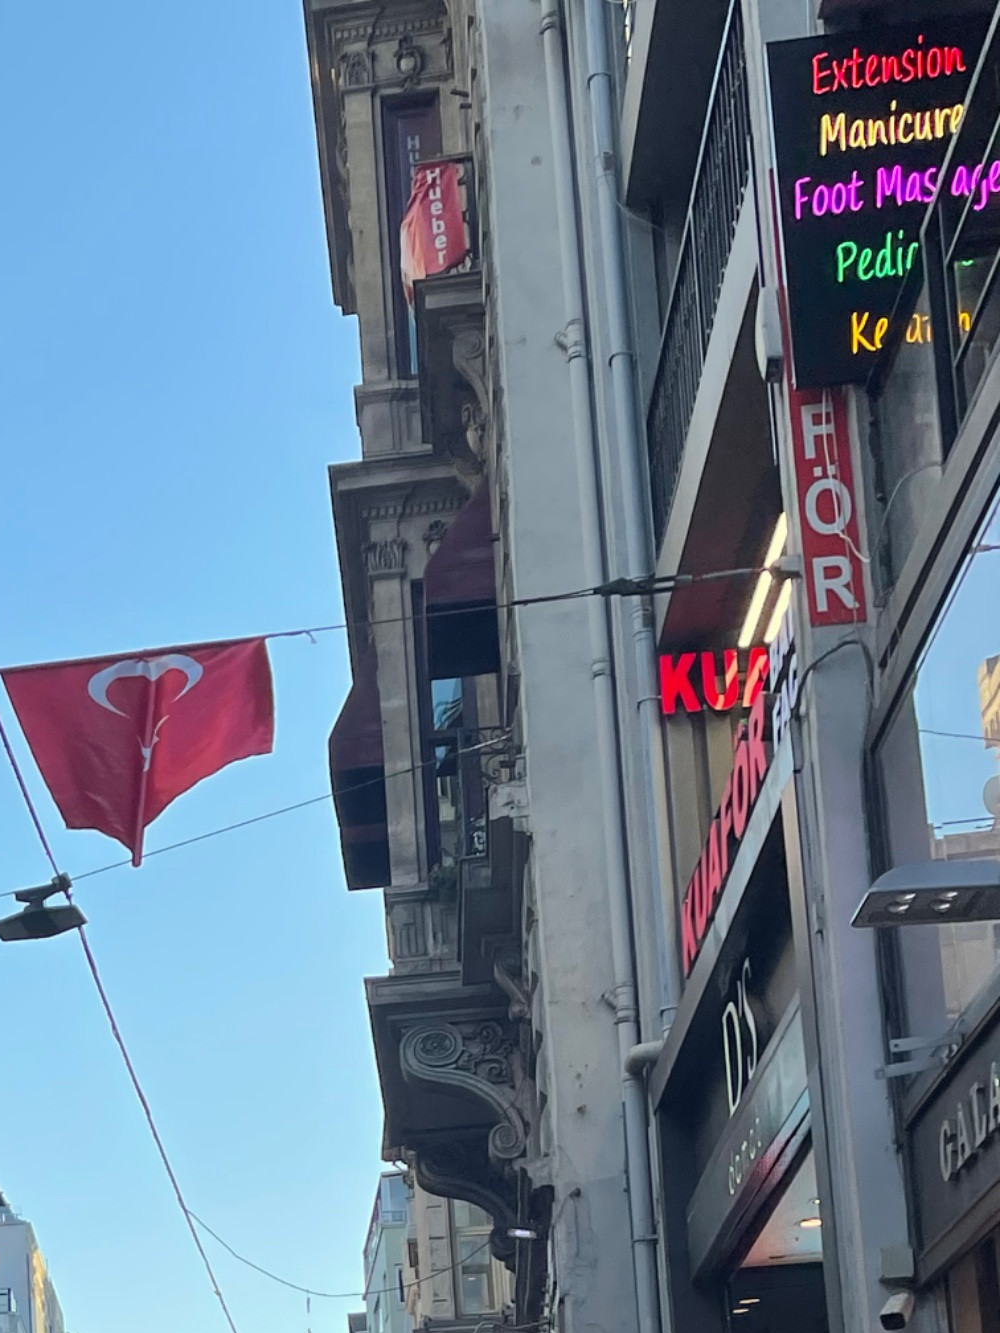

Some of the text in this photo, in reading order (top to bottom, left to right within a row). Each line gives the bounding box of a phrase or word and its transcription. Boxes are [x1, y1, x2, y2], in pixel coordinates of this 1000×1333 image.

[811, 34, 967, 95] Extension
[819, 100, 966, 157] Manicure
[426, 166, 448, 266] Hueber
[794, 151, 1000, 220] Foot Masage
[682, 690, 767, 979] KUAFÖR
[722, 956, 758, 1118] D'S
